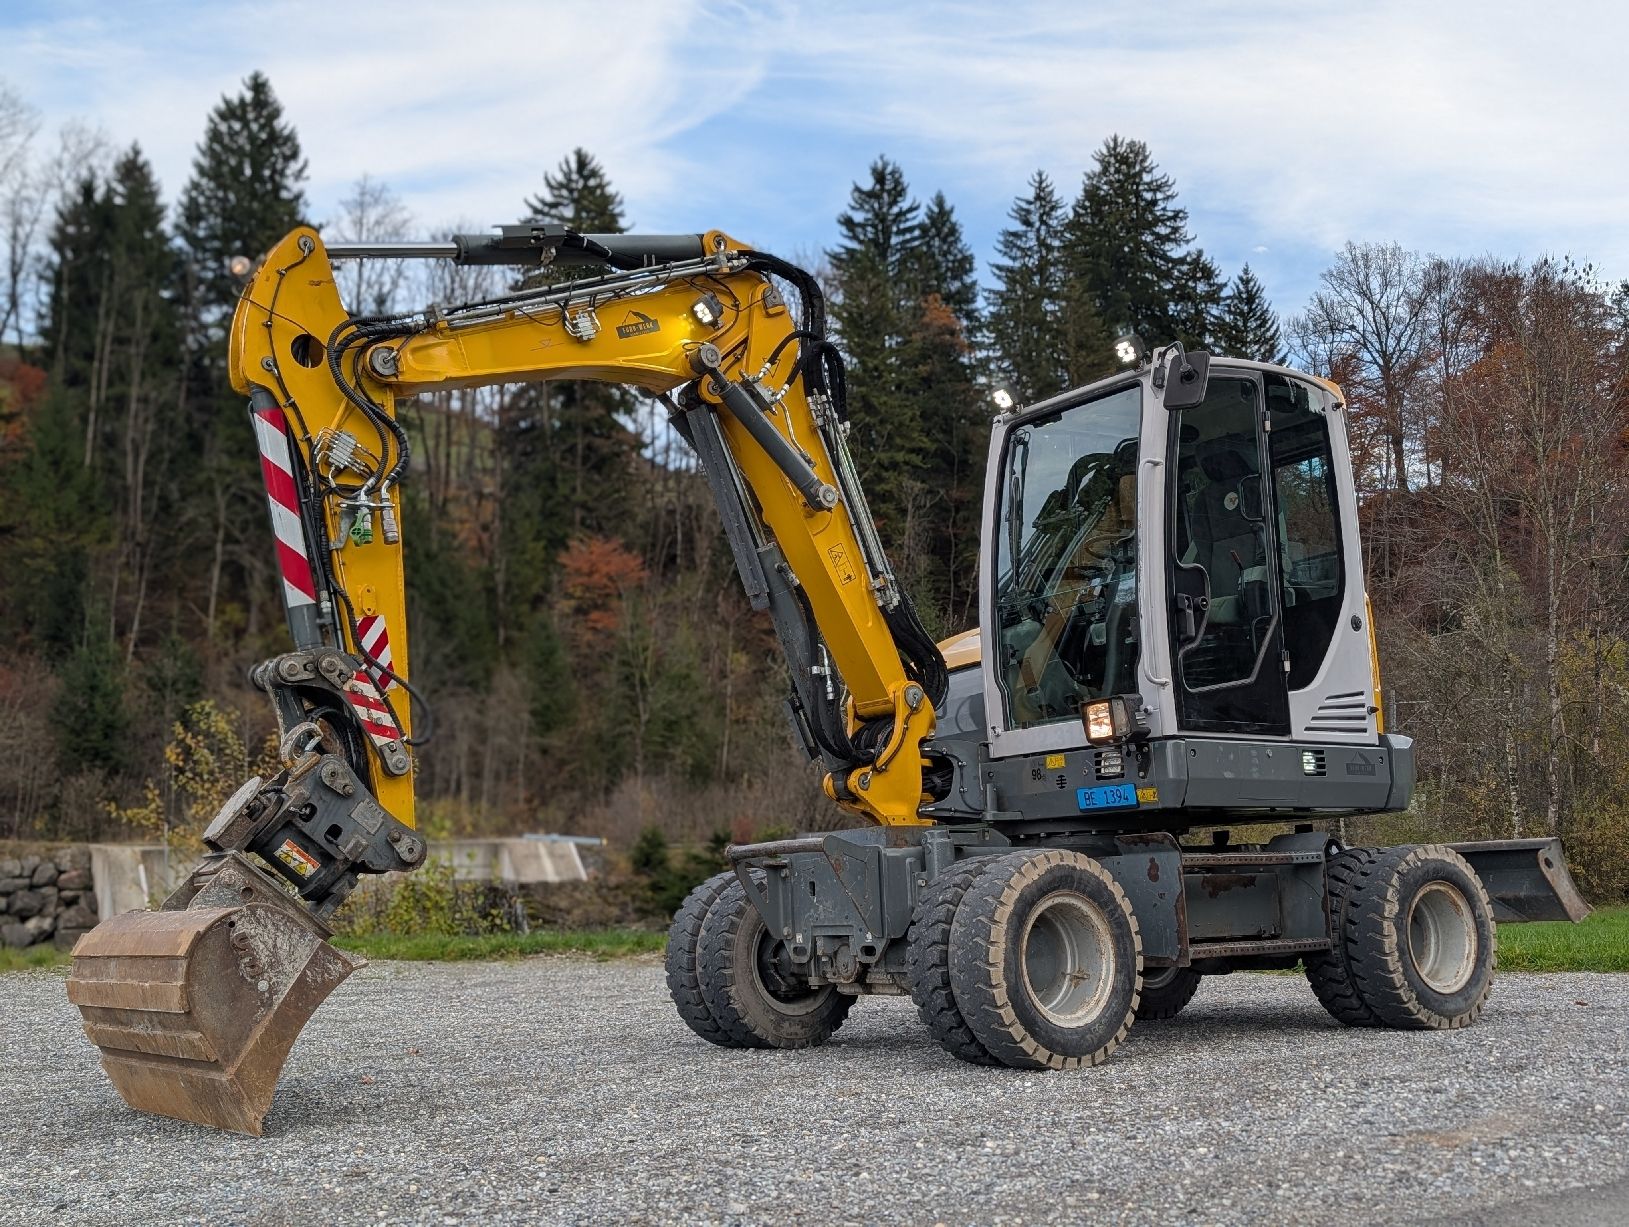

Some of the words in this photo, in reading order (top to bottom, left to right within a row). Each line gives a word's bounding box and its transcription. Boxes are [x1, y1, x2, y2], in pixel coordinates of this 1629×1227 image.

[1032, 768, 1042, 780] 98
[1083, 791, 1099, 807] BE
[1104, 788, 1129, 804] 1394
